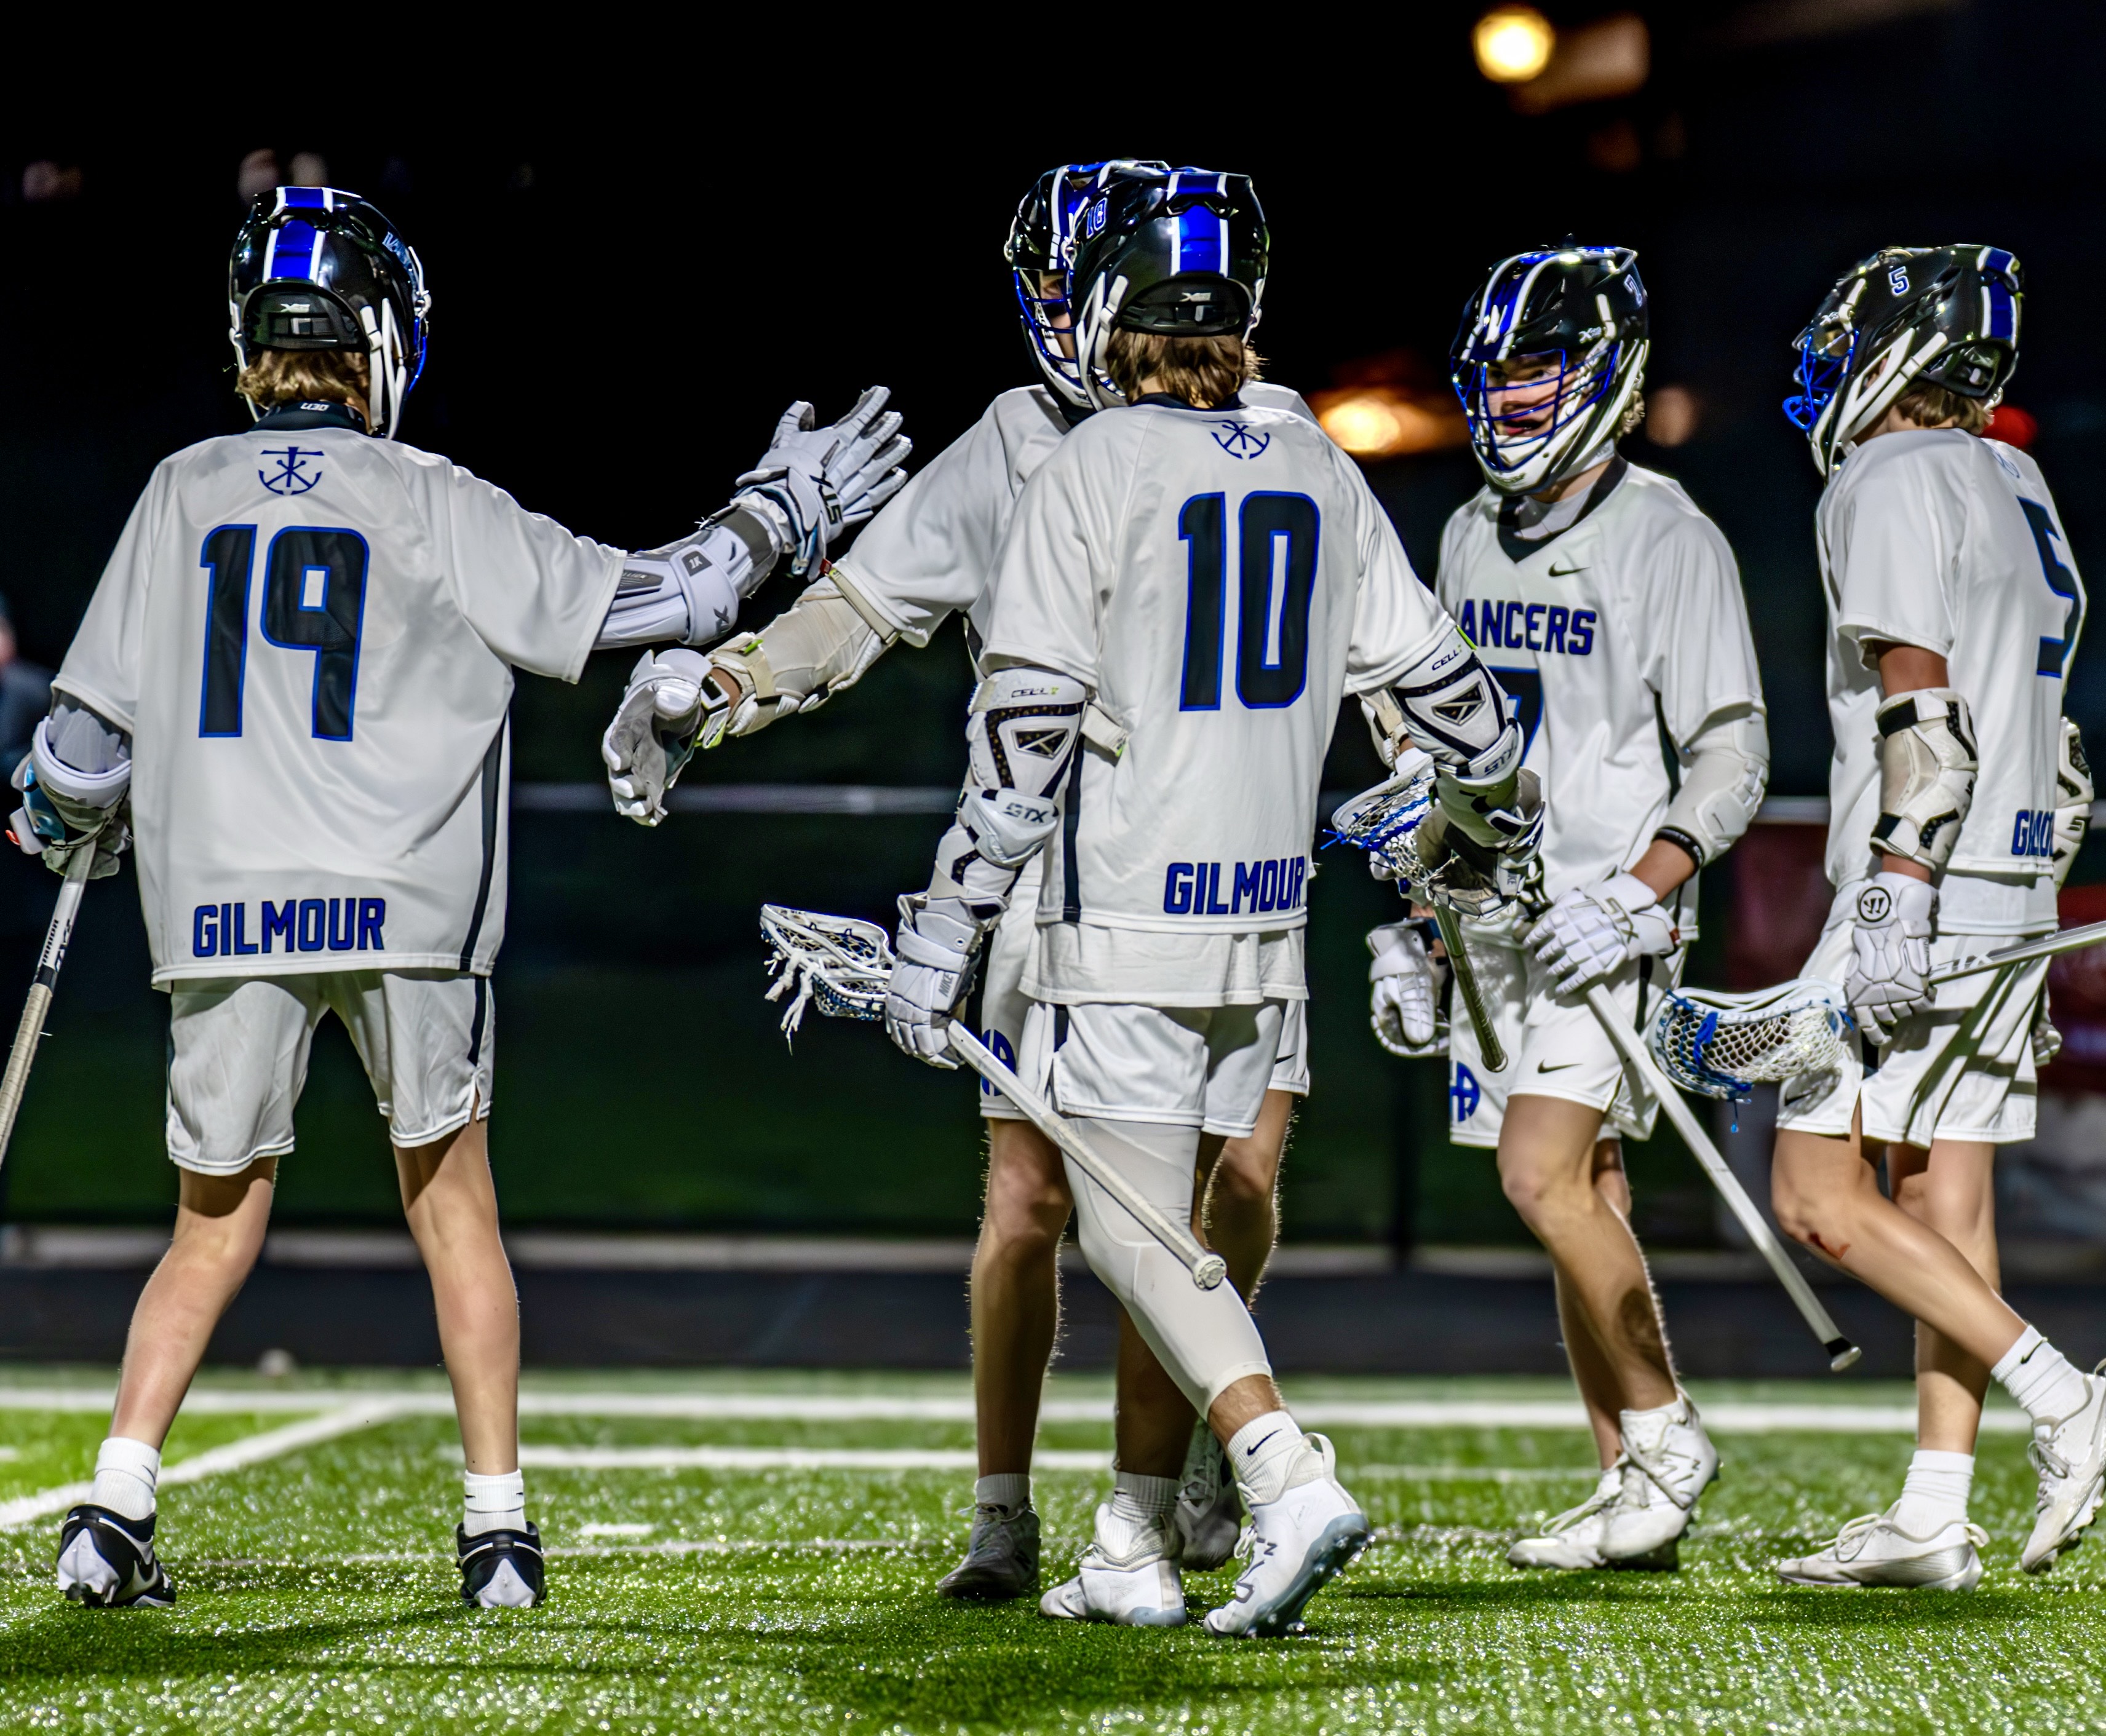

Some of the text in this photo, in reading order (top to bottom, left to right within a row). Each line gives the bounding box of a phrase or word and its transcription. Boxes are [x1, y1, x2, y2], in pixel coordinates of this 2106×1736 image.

[1888, 265, 1910, 296] 5
[1178, 490, 1321, 711] 10
[1461, 599, 1597, 656] ANCERS
[199, 524, 370, 742] 19
[1432, 649, 1459, 671] CELL
[1003, 802, 1049, 823] STX
[1163, 855, 1305, 914] GILMOUR
[193, 897, 386, 957] GILMOUR
[938, 972, 953, 997] NIKE
